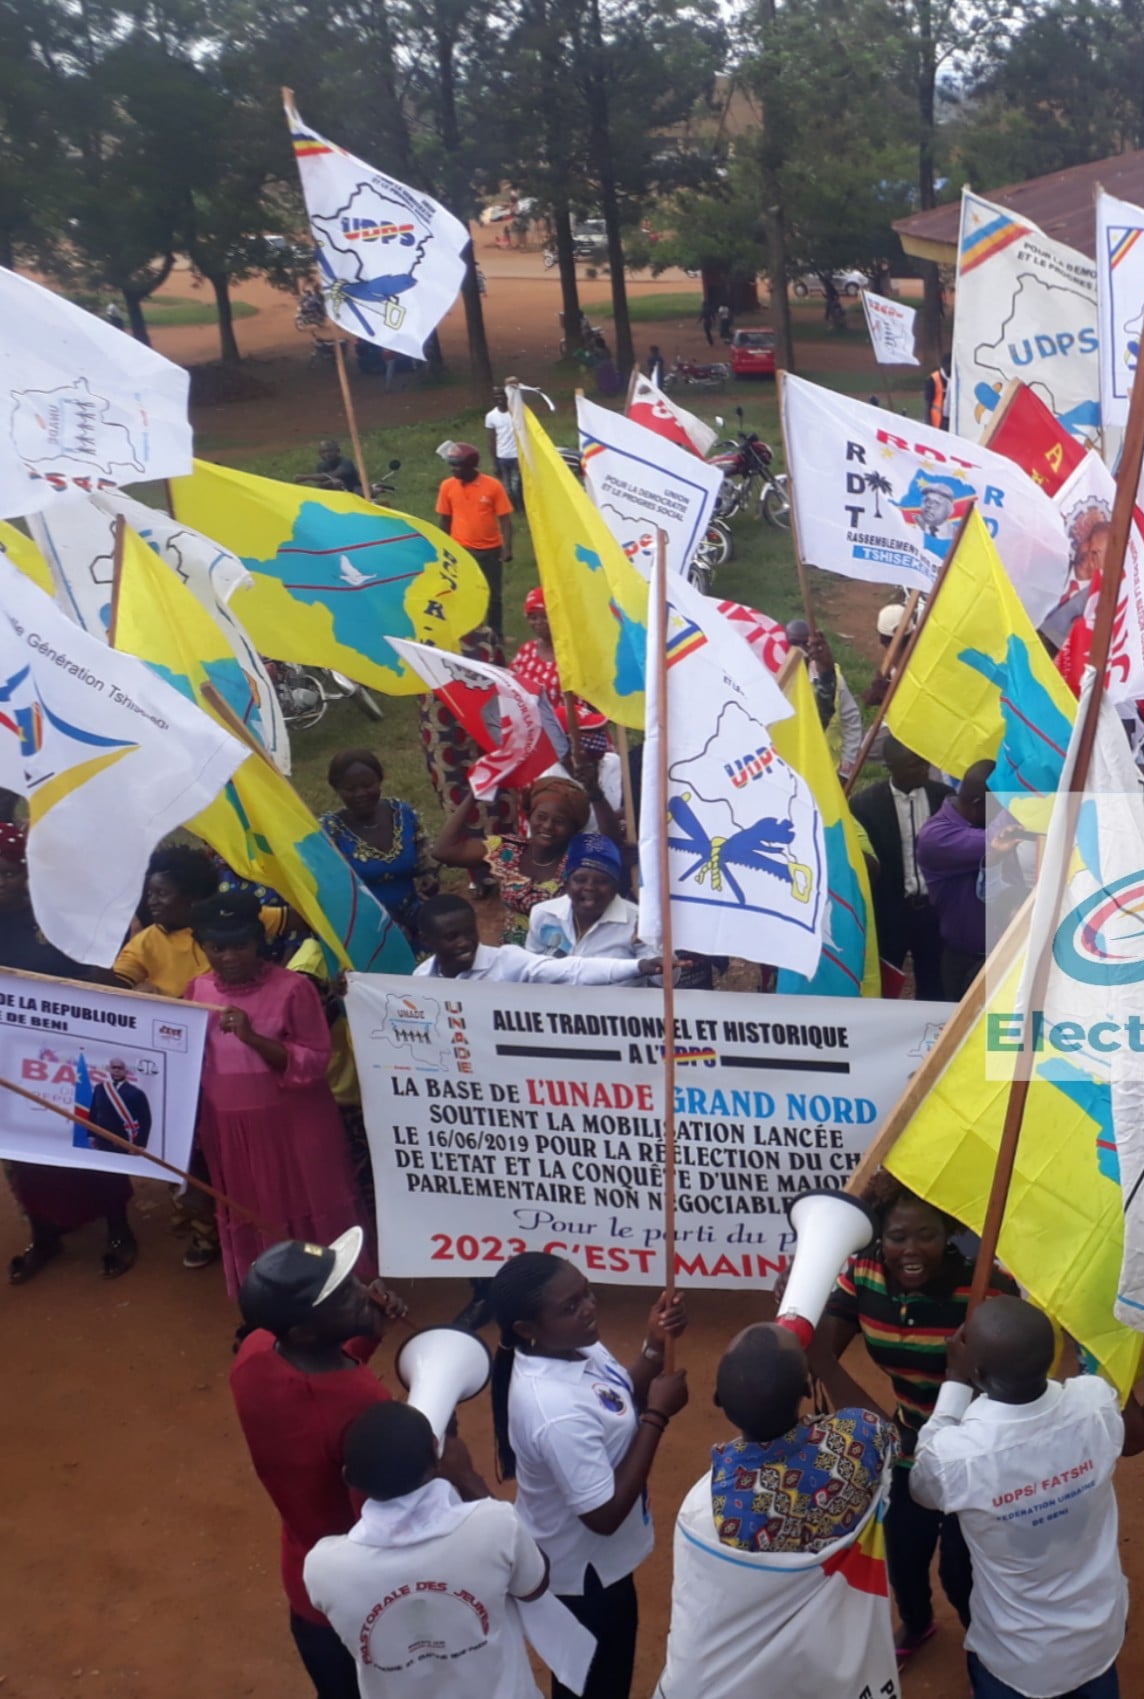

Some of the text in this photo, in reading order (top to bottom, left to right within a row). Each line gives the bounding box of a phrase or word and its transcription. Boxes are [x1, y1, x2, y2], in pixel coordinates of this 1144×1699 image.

[341, 216, 417, 248] UDPS
[1008, 327, 1100, 366] UDPS
[846, 531, 919, 557] RASSEMBLEMENT
[26, 630, 105, 694] Génération
[9, 1011, 69, 1033] DE BENI
[18, 995, 38, 1011] LA
[42, 999, 138, 1030] REPUBLIQUE
[493, 1009, 545, 1034] ALLIE
[696, 1019, 718, 1042] ET
[723, 1020, 850, 1049] HISTORIQUE
[628, 1043, 643, 1065] A
[391, 1075, 877, 1125] LA BASE DE L'UNADE GRAND NORD
[430, 1104, 844, 1150] SOUTIENT LA MOBILIATION LANCÉE
[392, 1125, 419, 1146] LE
[427, 1129, 529, 1154] 16/06/2019
[536, 1134, 597, 1159] POUR
[605, 1139, 632, 1161] LA
[790, 1152, 824, 1172] DU
[830, 1152, 862, 1172] CH
[395, 1148, 425, 1169] DE
[431, 1152, 497, 1176] L'ETAT
[506, 1158, 532, 1178] ET
[539, 1160, 567, 1180] LA
[573, 1161, 691, 1191] CONQUÊE
[700, 1171, 769, 1193] D'UNE
[407, 1172, 794, 1216] PARLEMENTAIRE NON NGOCIABLE
[513, 1208, 598, 1236] Pour
[609, 1215, 634, 1239] le
[727, 1223, 768, 1245] du
[673, 1253, 789, 1279] MAIN
[992, 1459, 1094, 1509] UDPS/ FATSHI
[1031, 1517, 1045, 1528] DE
[359, 1585, 412, 1665] PASTORALE
[416, 1581, 448, 1593] DES
